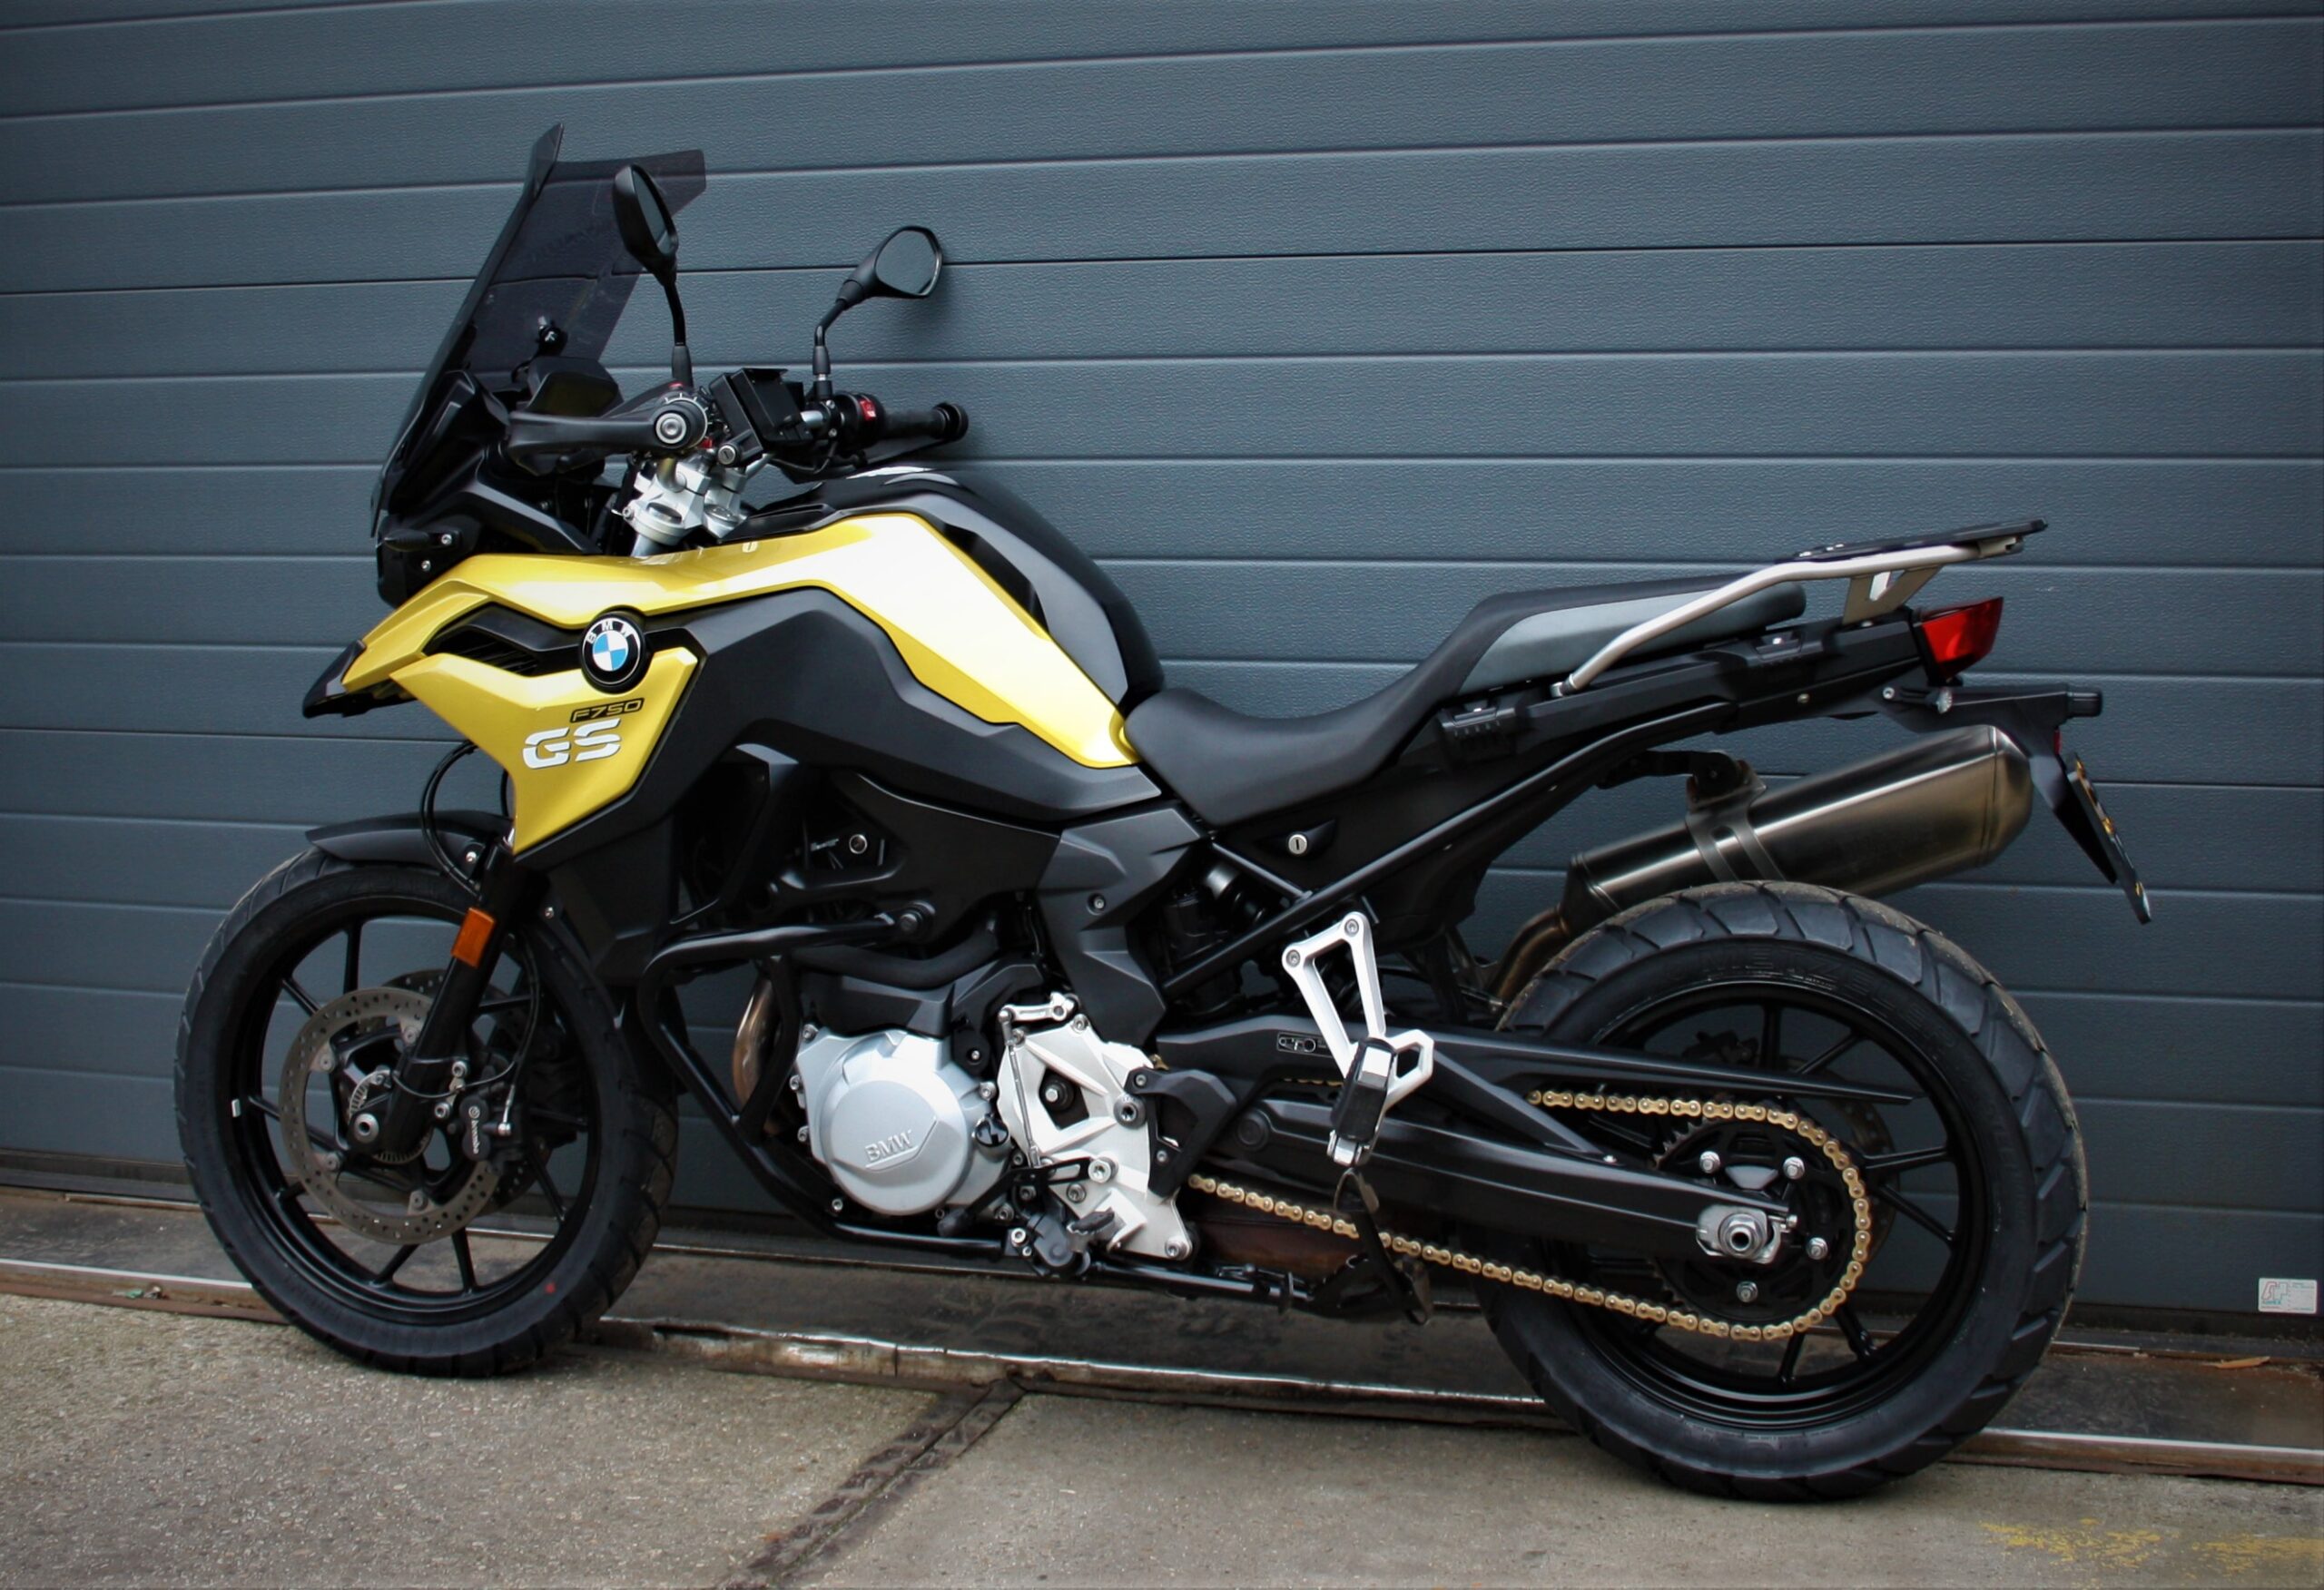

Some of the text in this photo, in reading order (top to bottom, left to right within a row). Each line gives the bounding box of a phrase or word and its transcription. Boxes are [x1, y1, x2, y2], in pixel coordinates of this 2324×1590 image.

[586, 619, 635, 644] BMW
[572, 698, 642, 722] F750
[522, 718, 621, 770] GS
[864, 1129, 912, 1162] BMW
